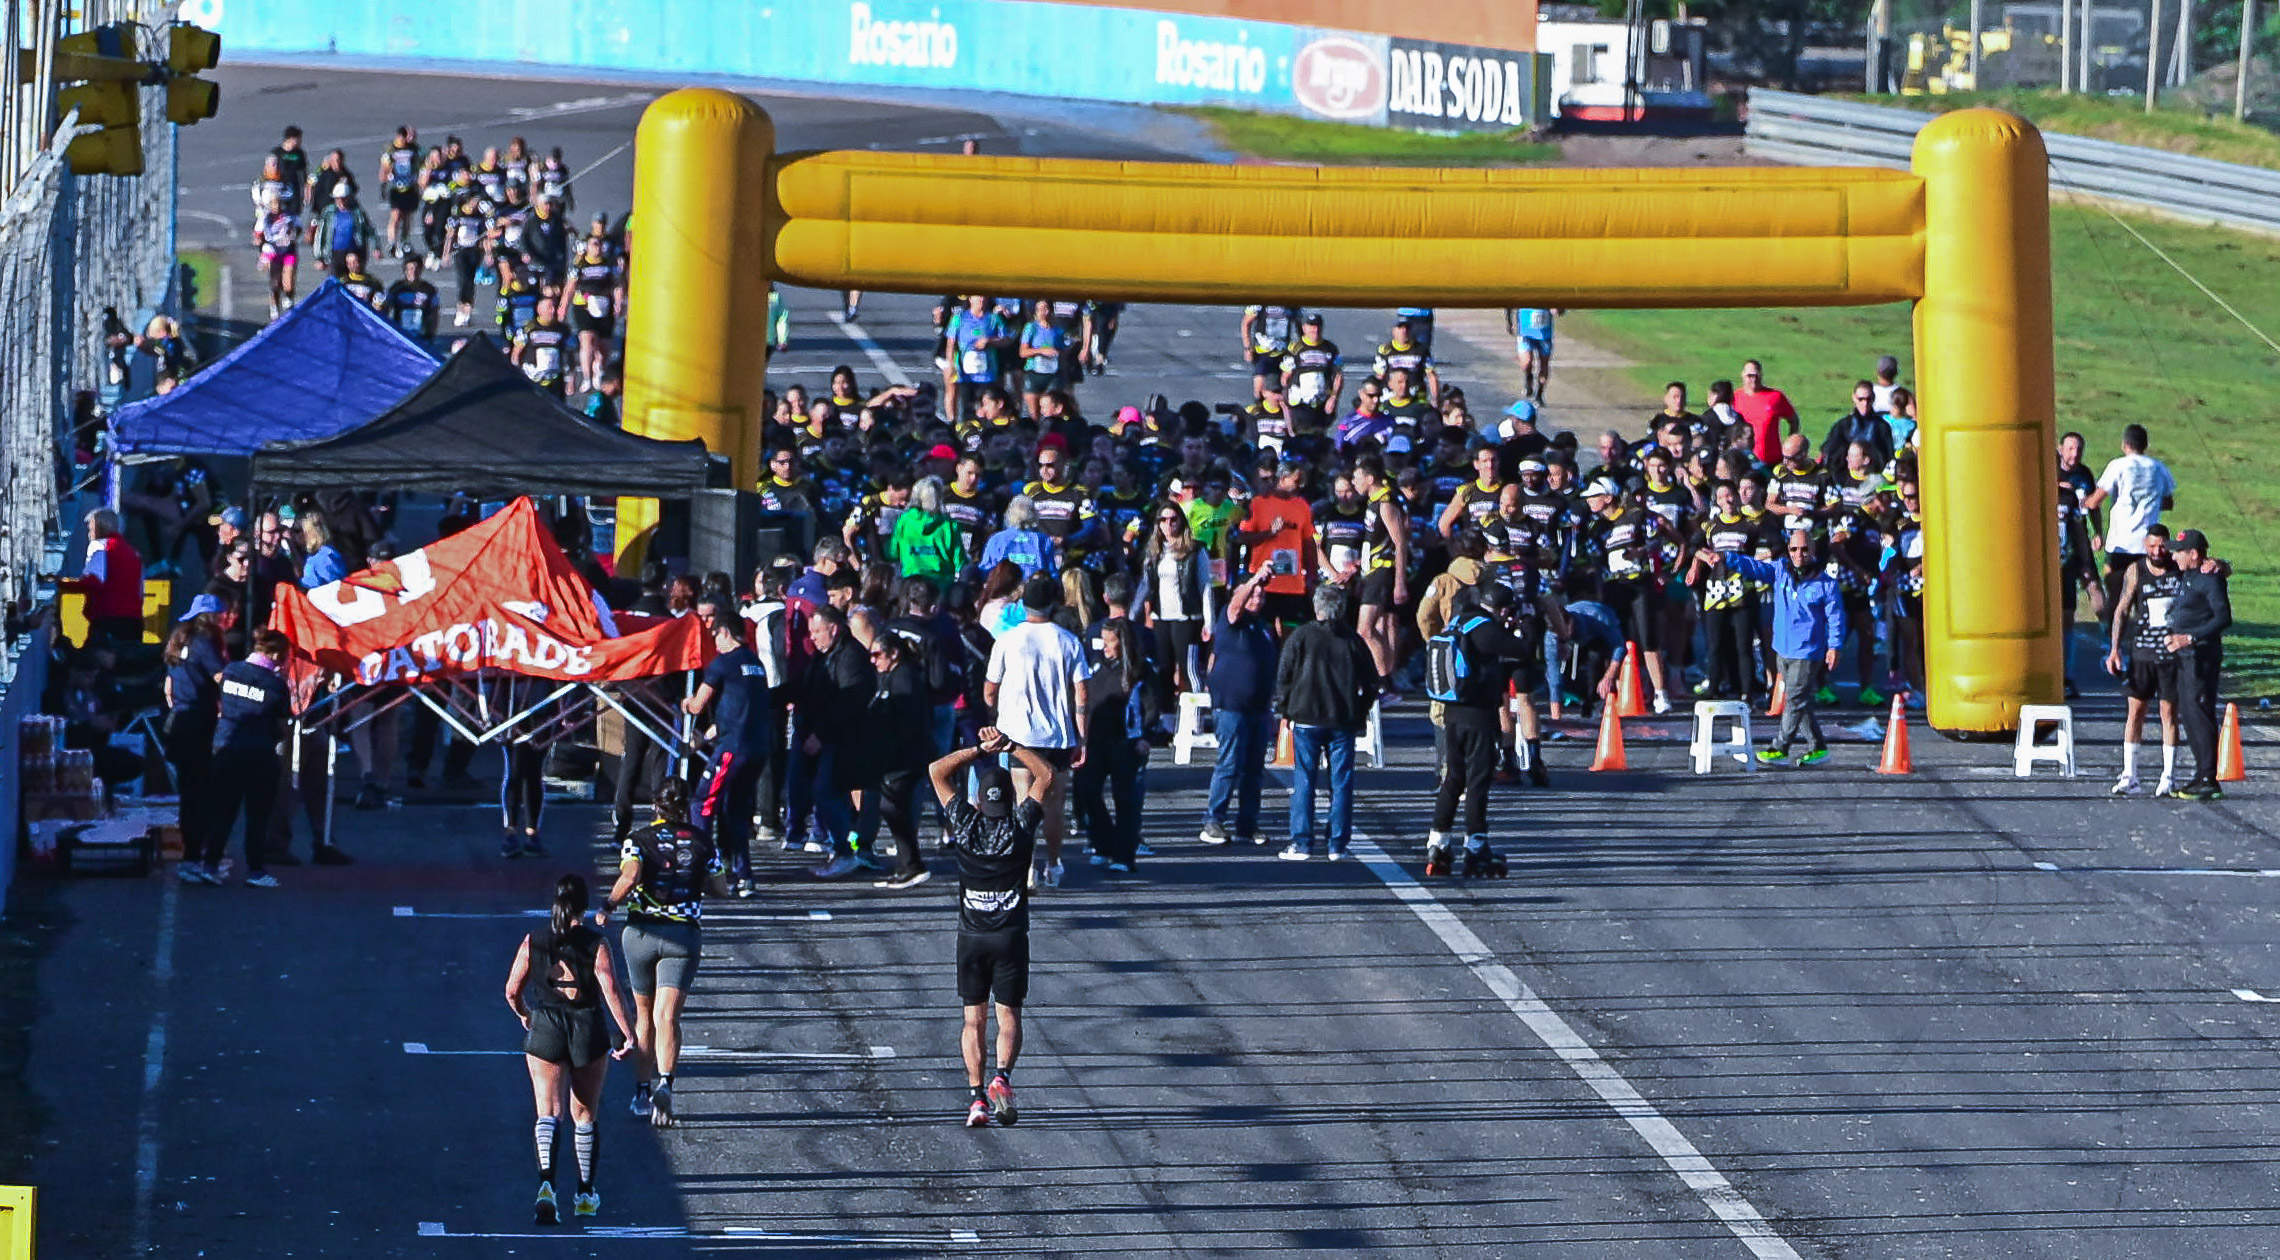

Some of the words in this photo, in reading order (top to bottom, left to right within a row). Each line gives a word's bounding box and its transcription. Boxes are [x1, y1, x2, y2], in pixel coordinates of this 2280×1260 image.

[849, 2, 958, 68] Rosario
[1155, 20, 1266, 93] Rosario
[359, 618, 593, 686] GATORADE
